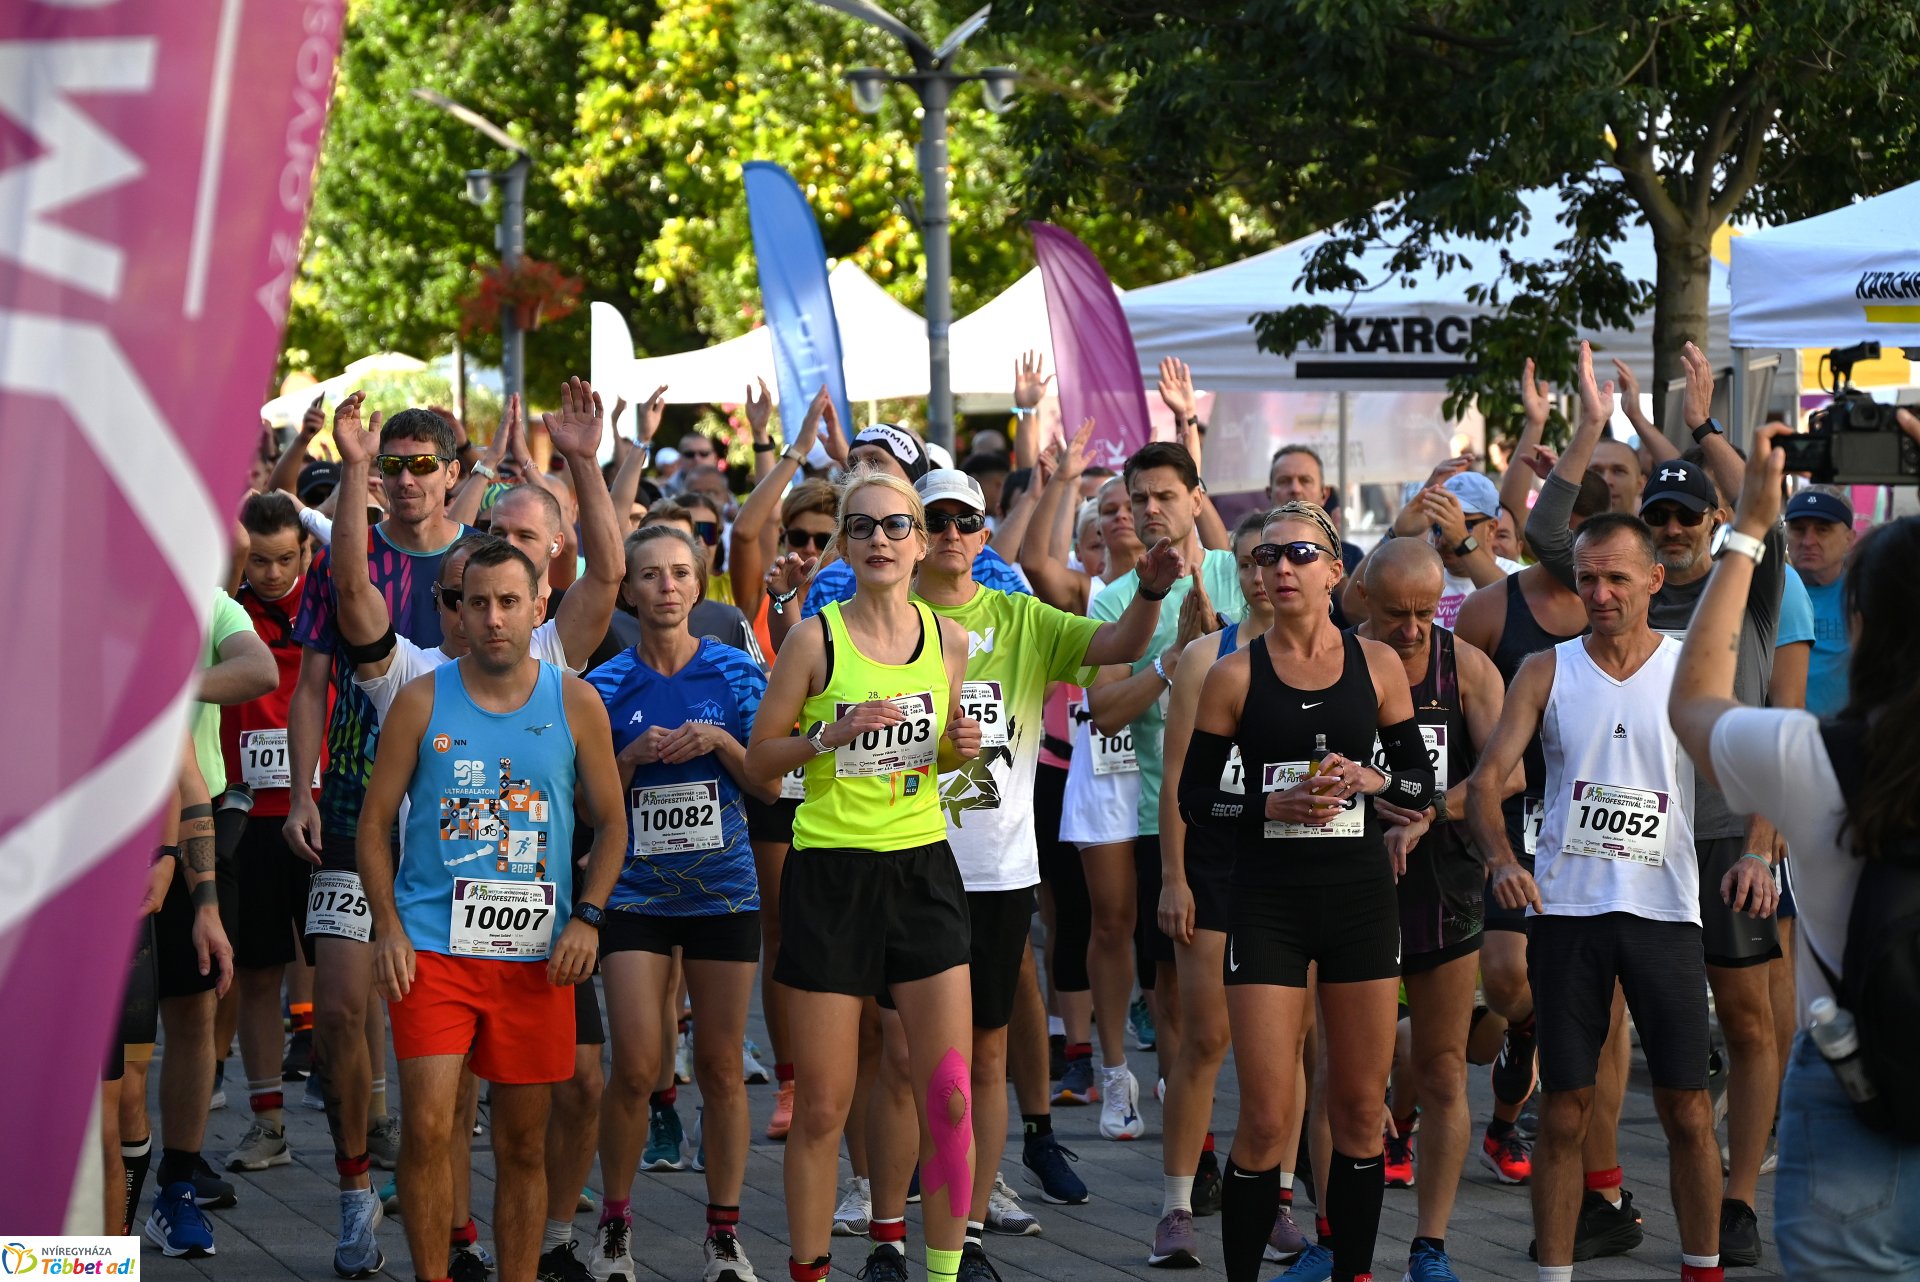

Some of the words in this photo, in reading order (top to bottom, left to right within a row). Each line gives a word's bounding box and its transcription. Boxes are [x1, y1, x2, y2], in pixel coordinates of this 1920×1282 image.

[1335, 316, 1472, 353] KÄRC
[862, 428, 912, 457] GARMIN
[959, 703, 998, 724] 55
[1099, 735, 1134, 754] 100
[249, 748, 285, 768] 101
[641, 804, 713, 832] 10082
[1579, 805, 1660, 839] 10052
[511, 863, 534, 874] 2025
[478, 893, 529, 903] FUTÓFESZTIVÁL
[464, 904, 550, 931] 10007
